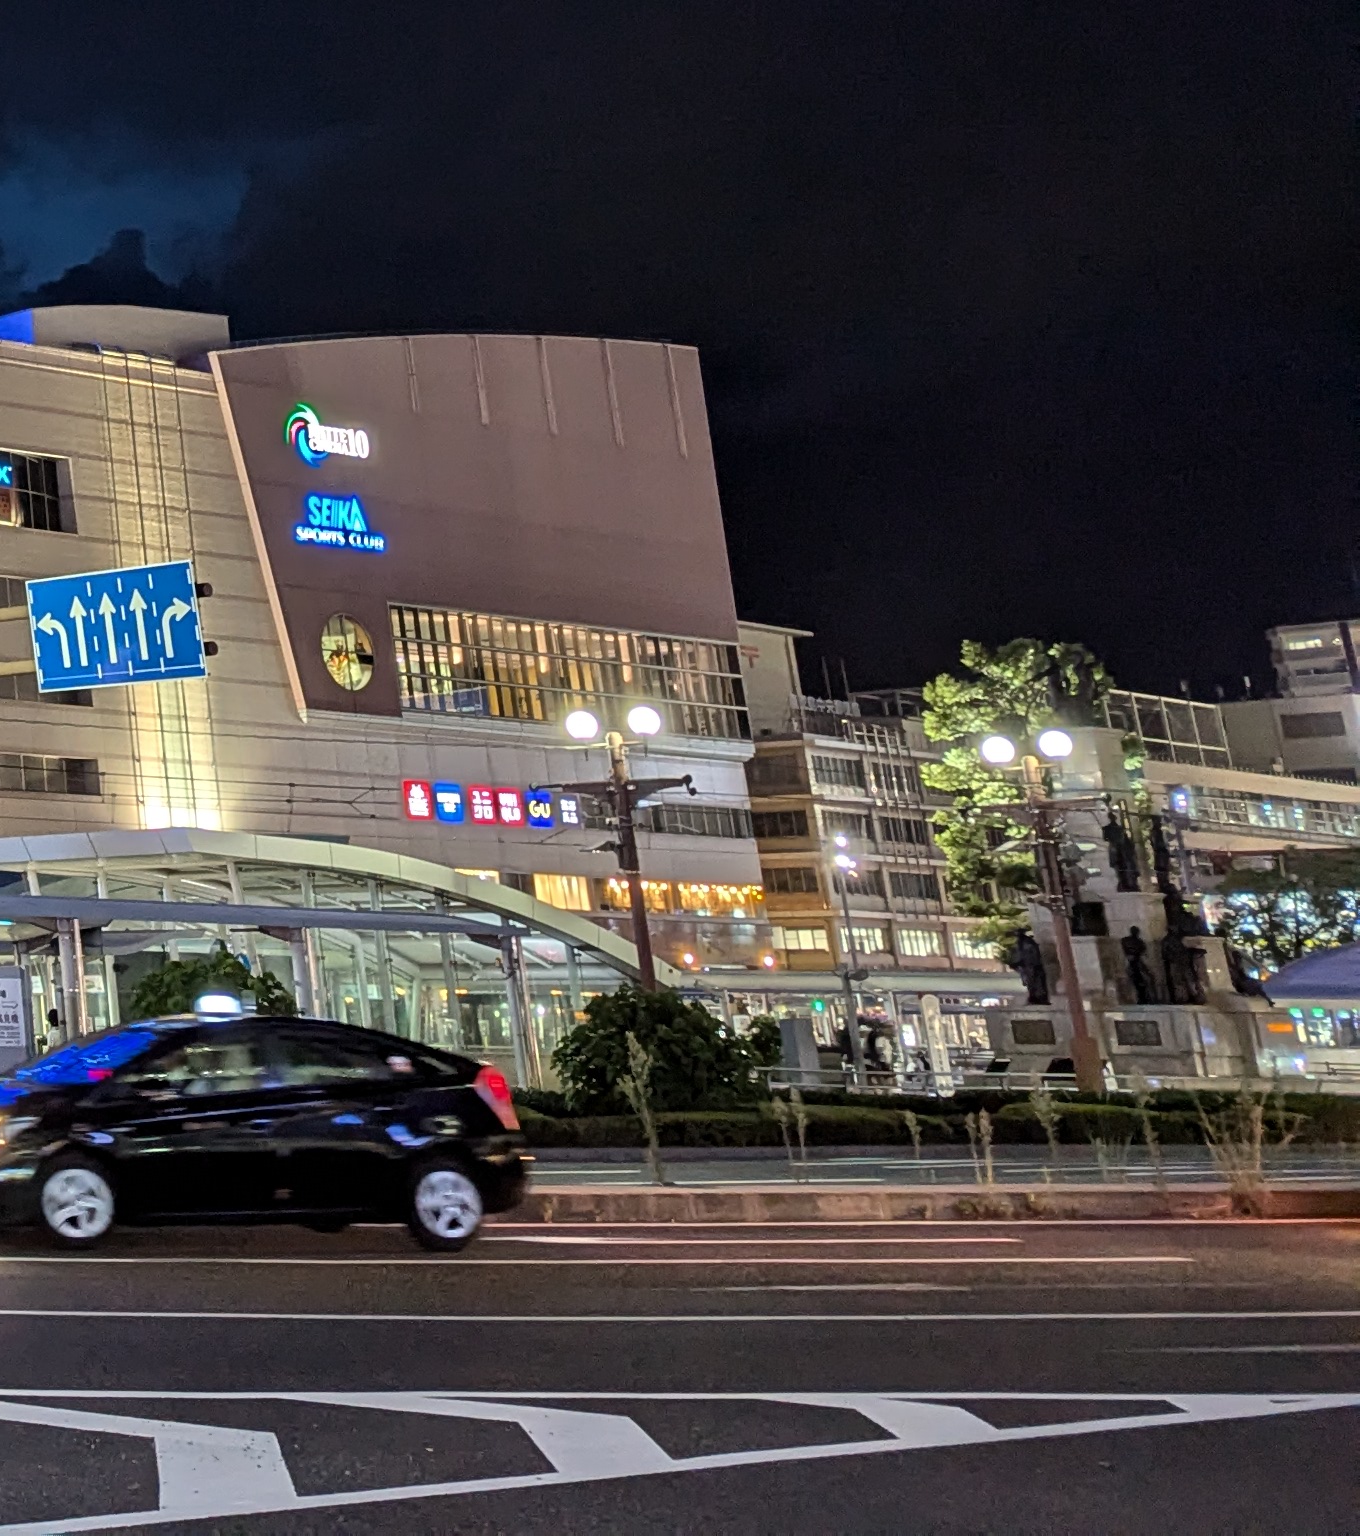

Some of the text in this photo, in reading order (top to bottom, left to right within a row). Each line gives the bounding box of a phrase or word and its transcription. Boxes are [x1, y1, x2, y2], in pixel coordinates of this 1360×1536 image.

[308, 495, 368, 532] SEIKA
[296, 525, 385, 552] SPORTS CLUB
[472, 790, 492, 805] ユニ
[473, 804, 494, 820] クロ
[528, 800, 551, 819] GU
